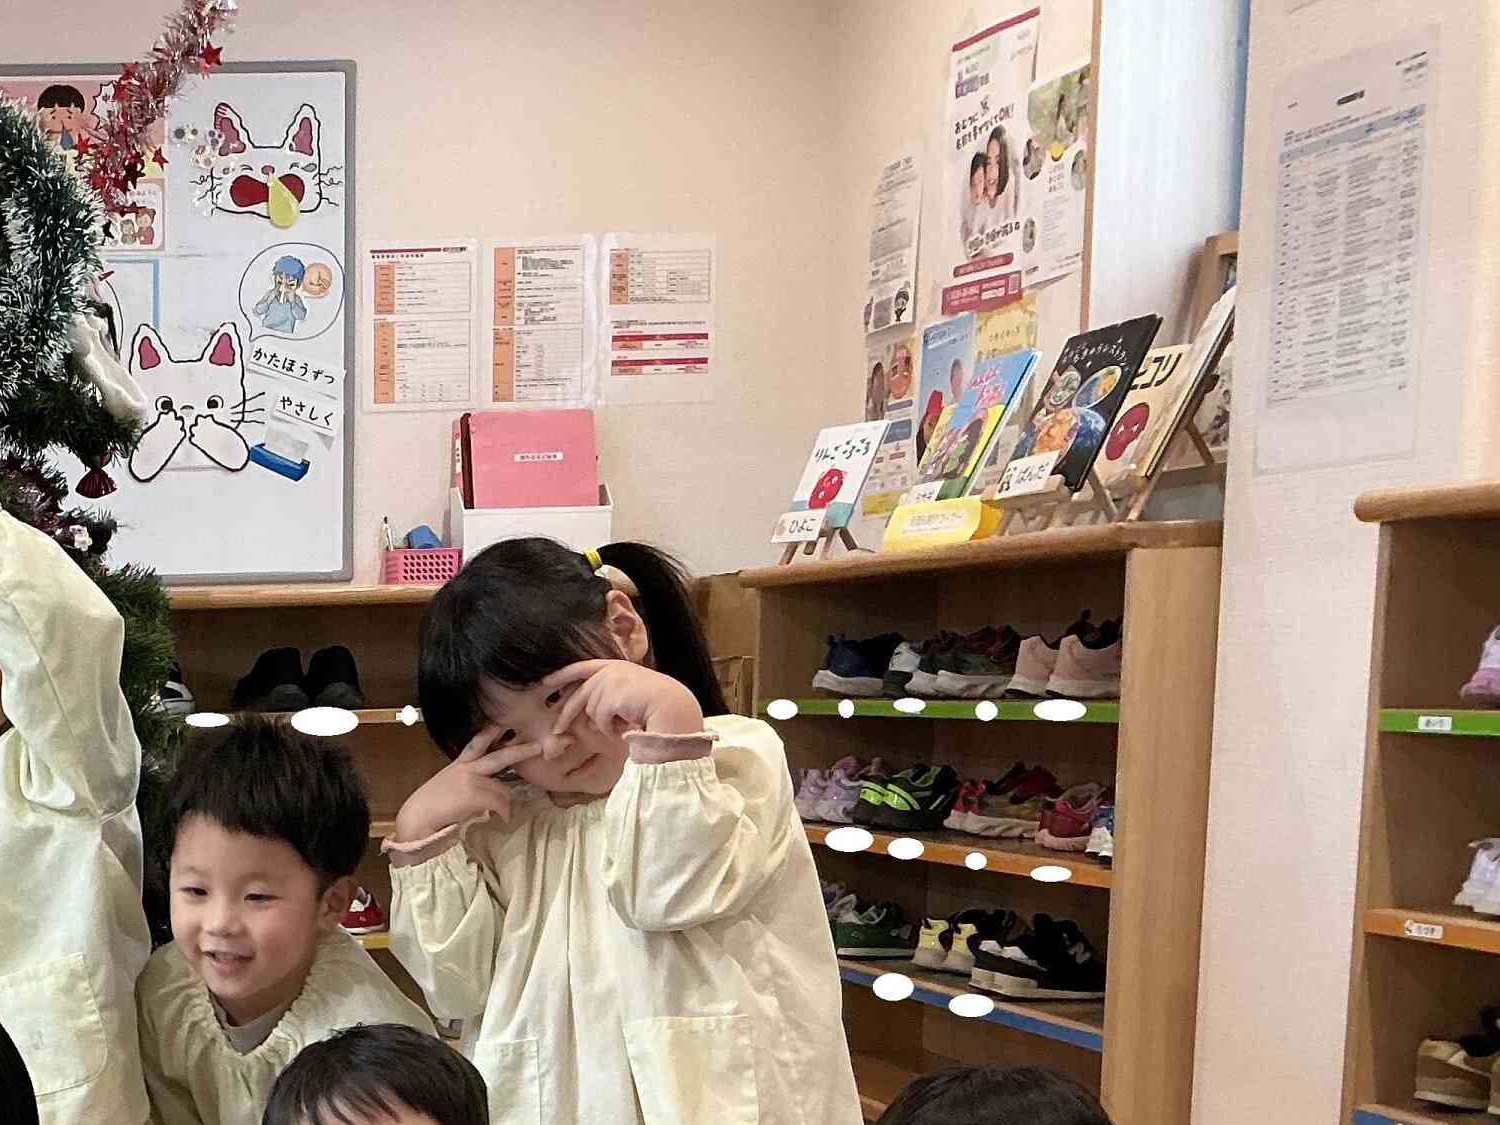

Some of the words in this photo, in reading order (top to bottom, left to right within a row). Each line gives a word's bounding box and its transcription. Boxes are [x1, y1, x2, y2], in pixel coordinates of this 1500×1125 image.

[253, 347, 335, 384] かたほうずつ
[280, 396, 333, 426] やさしく
